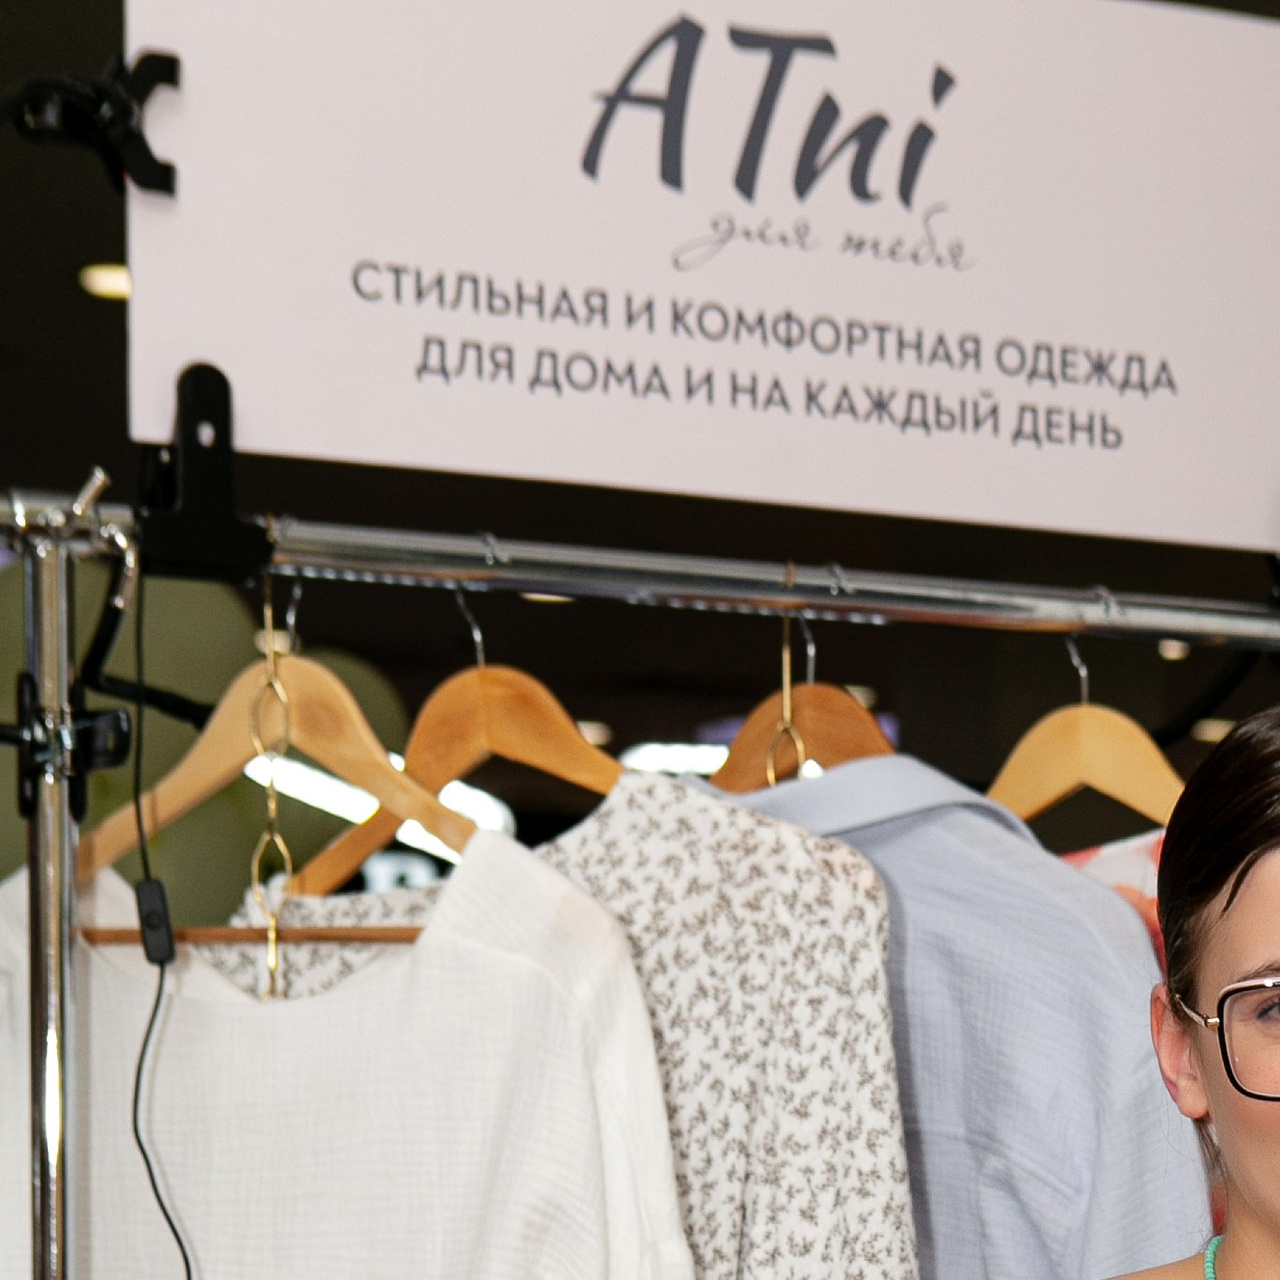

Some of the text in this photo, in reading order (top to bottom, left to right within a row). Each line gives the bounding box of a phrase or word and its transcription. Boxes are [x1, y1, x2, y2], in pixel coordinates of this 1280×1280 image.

[580, 13, 957, 211] ATni
[671, 204, 976, 273] для тебя
[350, 261, 1178, 398] СТИЛЬНАЯ И КОМФОРТНАЯ ОДЕЖДА
[414, 336, 1124, 451] ДЛЯ ДОМА И НА КАЖДЫЙ ДЕНЬ
